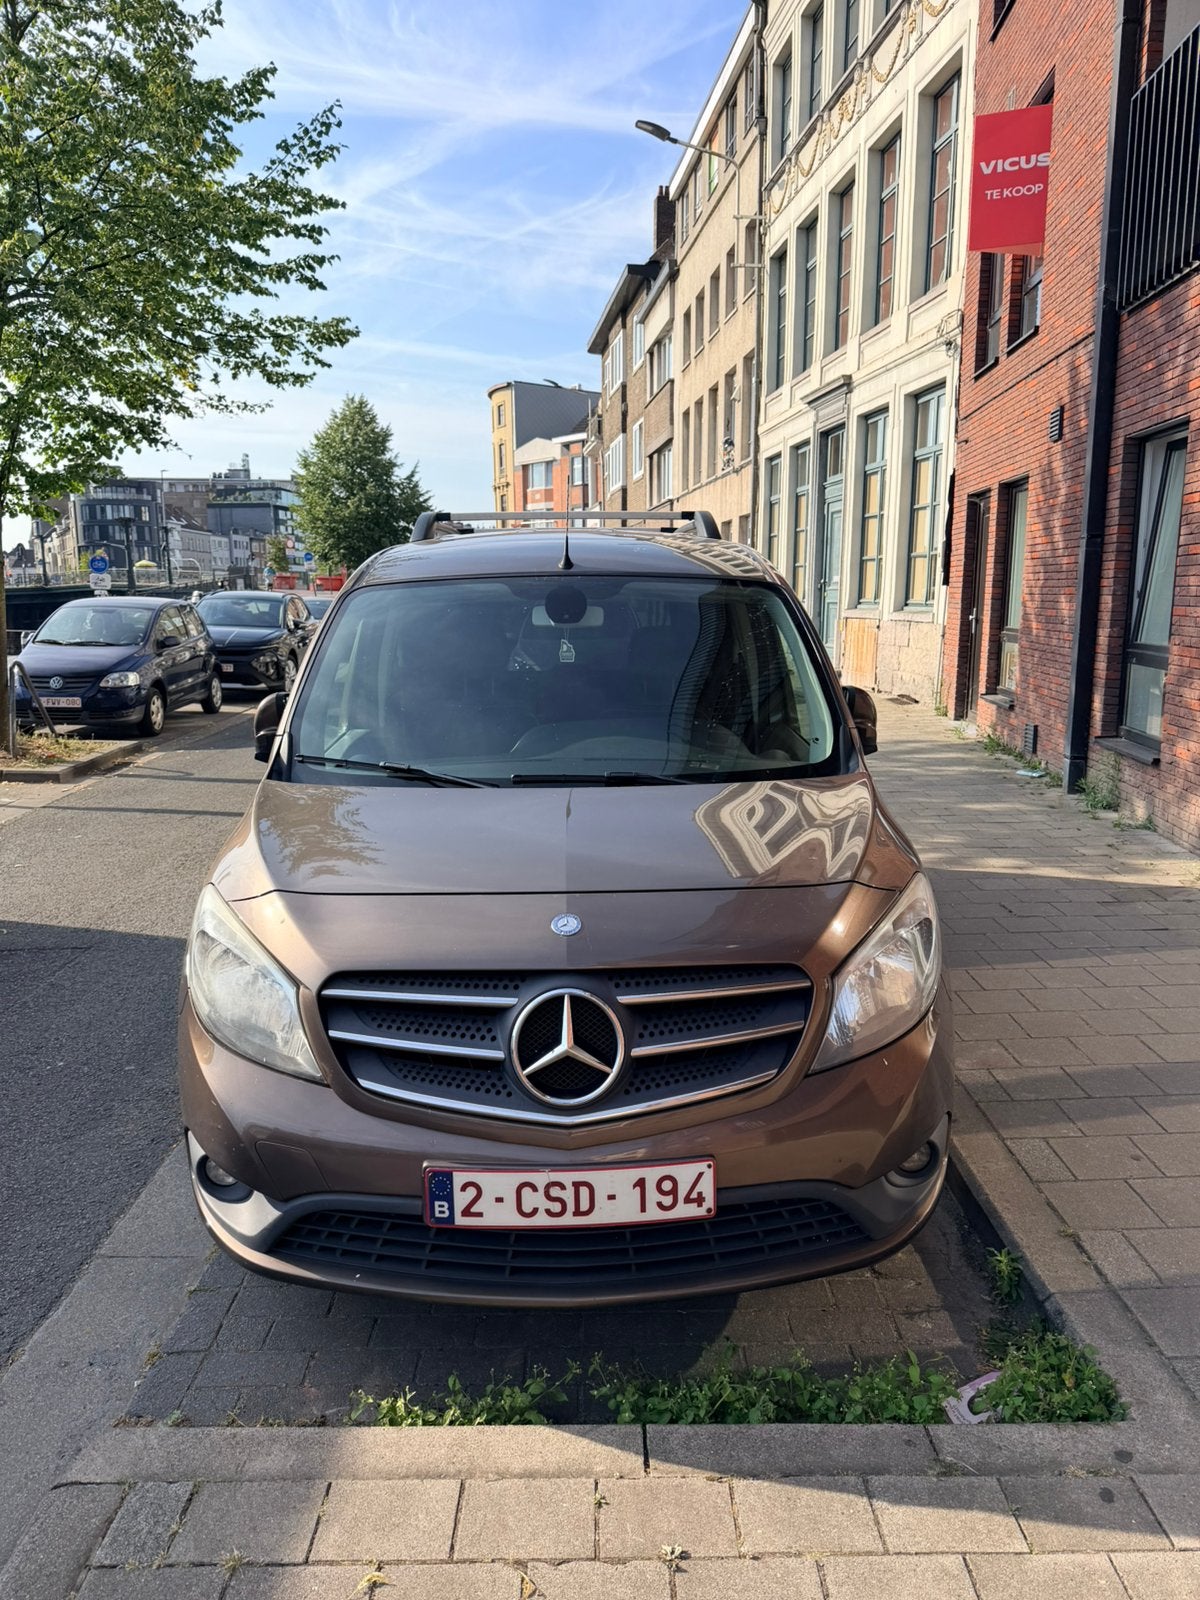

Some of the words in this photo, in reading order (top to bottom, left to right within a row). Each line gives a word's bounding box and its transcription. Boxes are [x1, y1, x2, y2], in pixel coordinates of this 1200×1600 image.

[979, 152, 1051, 175] VICUS
[985, 189, 1002, 200] TE
[1003, 183, 1044, 198] KOOP
[434, 1200, 450, 1218] B
